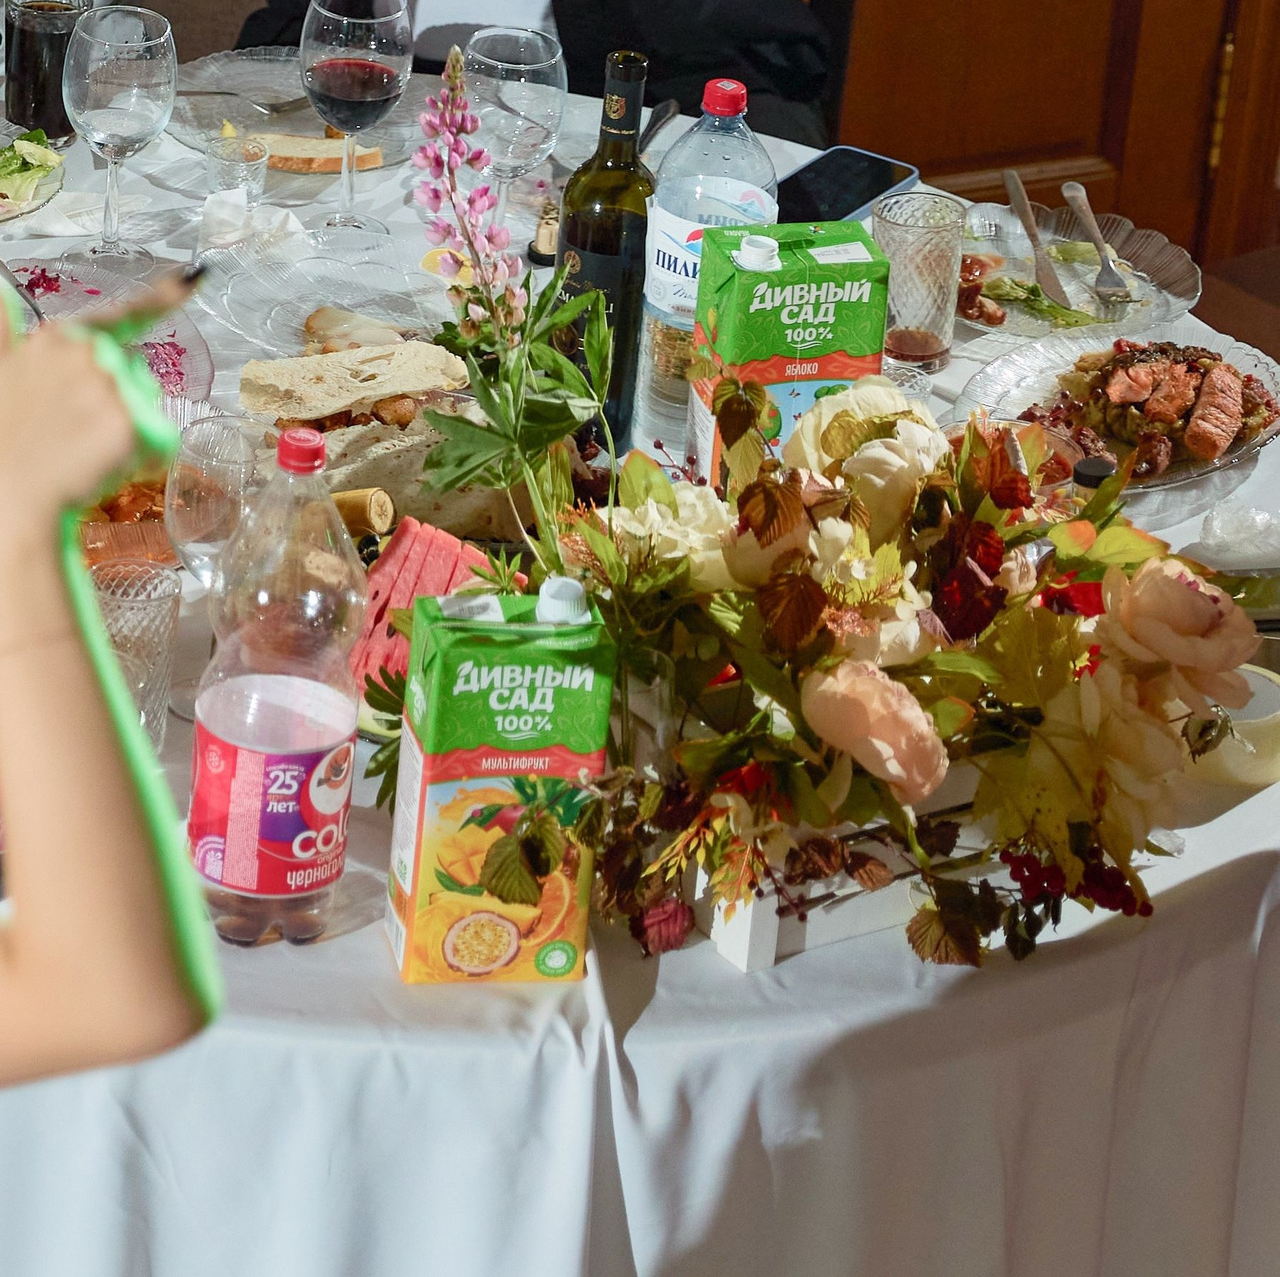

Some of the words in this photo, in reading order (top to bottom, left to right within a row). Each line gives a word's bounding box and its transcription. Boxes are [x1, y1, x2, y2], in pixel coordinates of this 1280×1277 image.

[749, 279, 872, 313] ДИВНЫЙ
[780, 303, 836, 325] САД
[784, 326, 834, 343] 100%
[785, 362, 819, 376] ЯБЛОКО
[452, 660, 595, 696] ДИВНЫЙ
[488, 688, 555, 713] САД
[494, 715, 553, 732] 100%
[481, 756, 550, 770] МУЛЬТИФРУКТ
[267, 770, 299, 795] 25
[266, 801, 296, 813] лет
